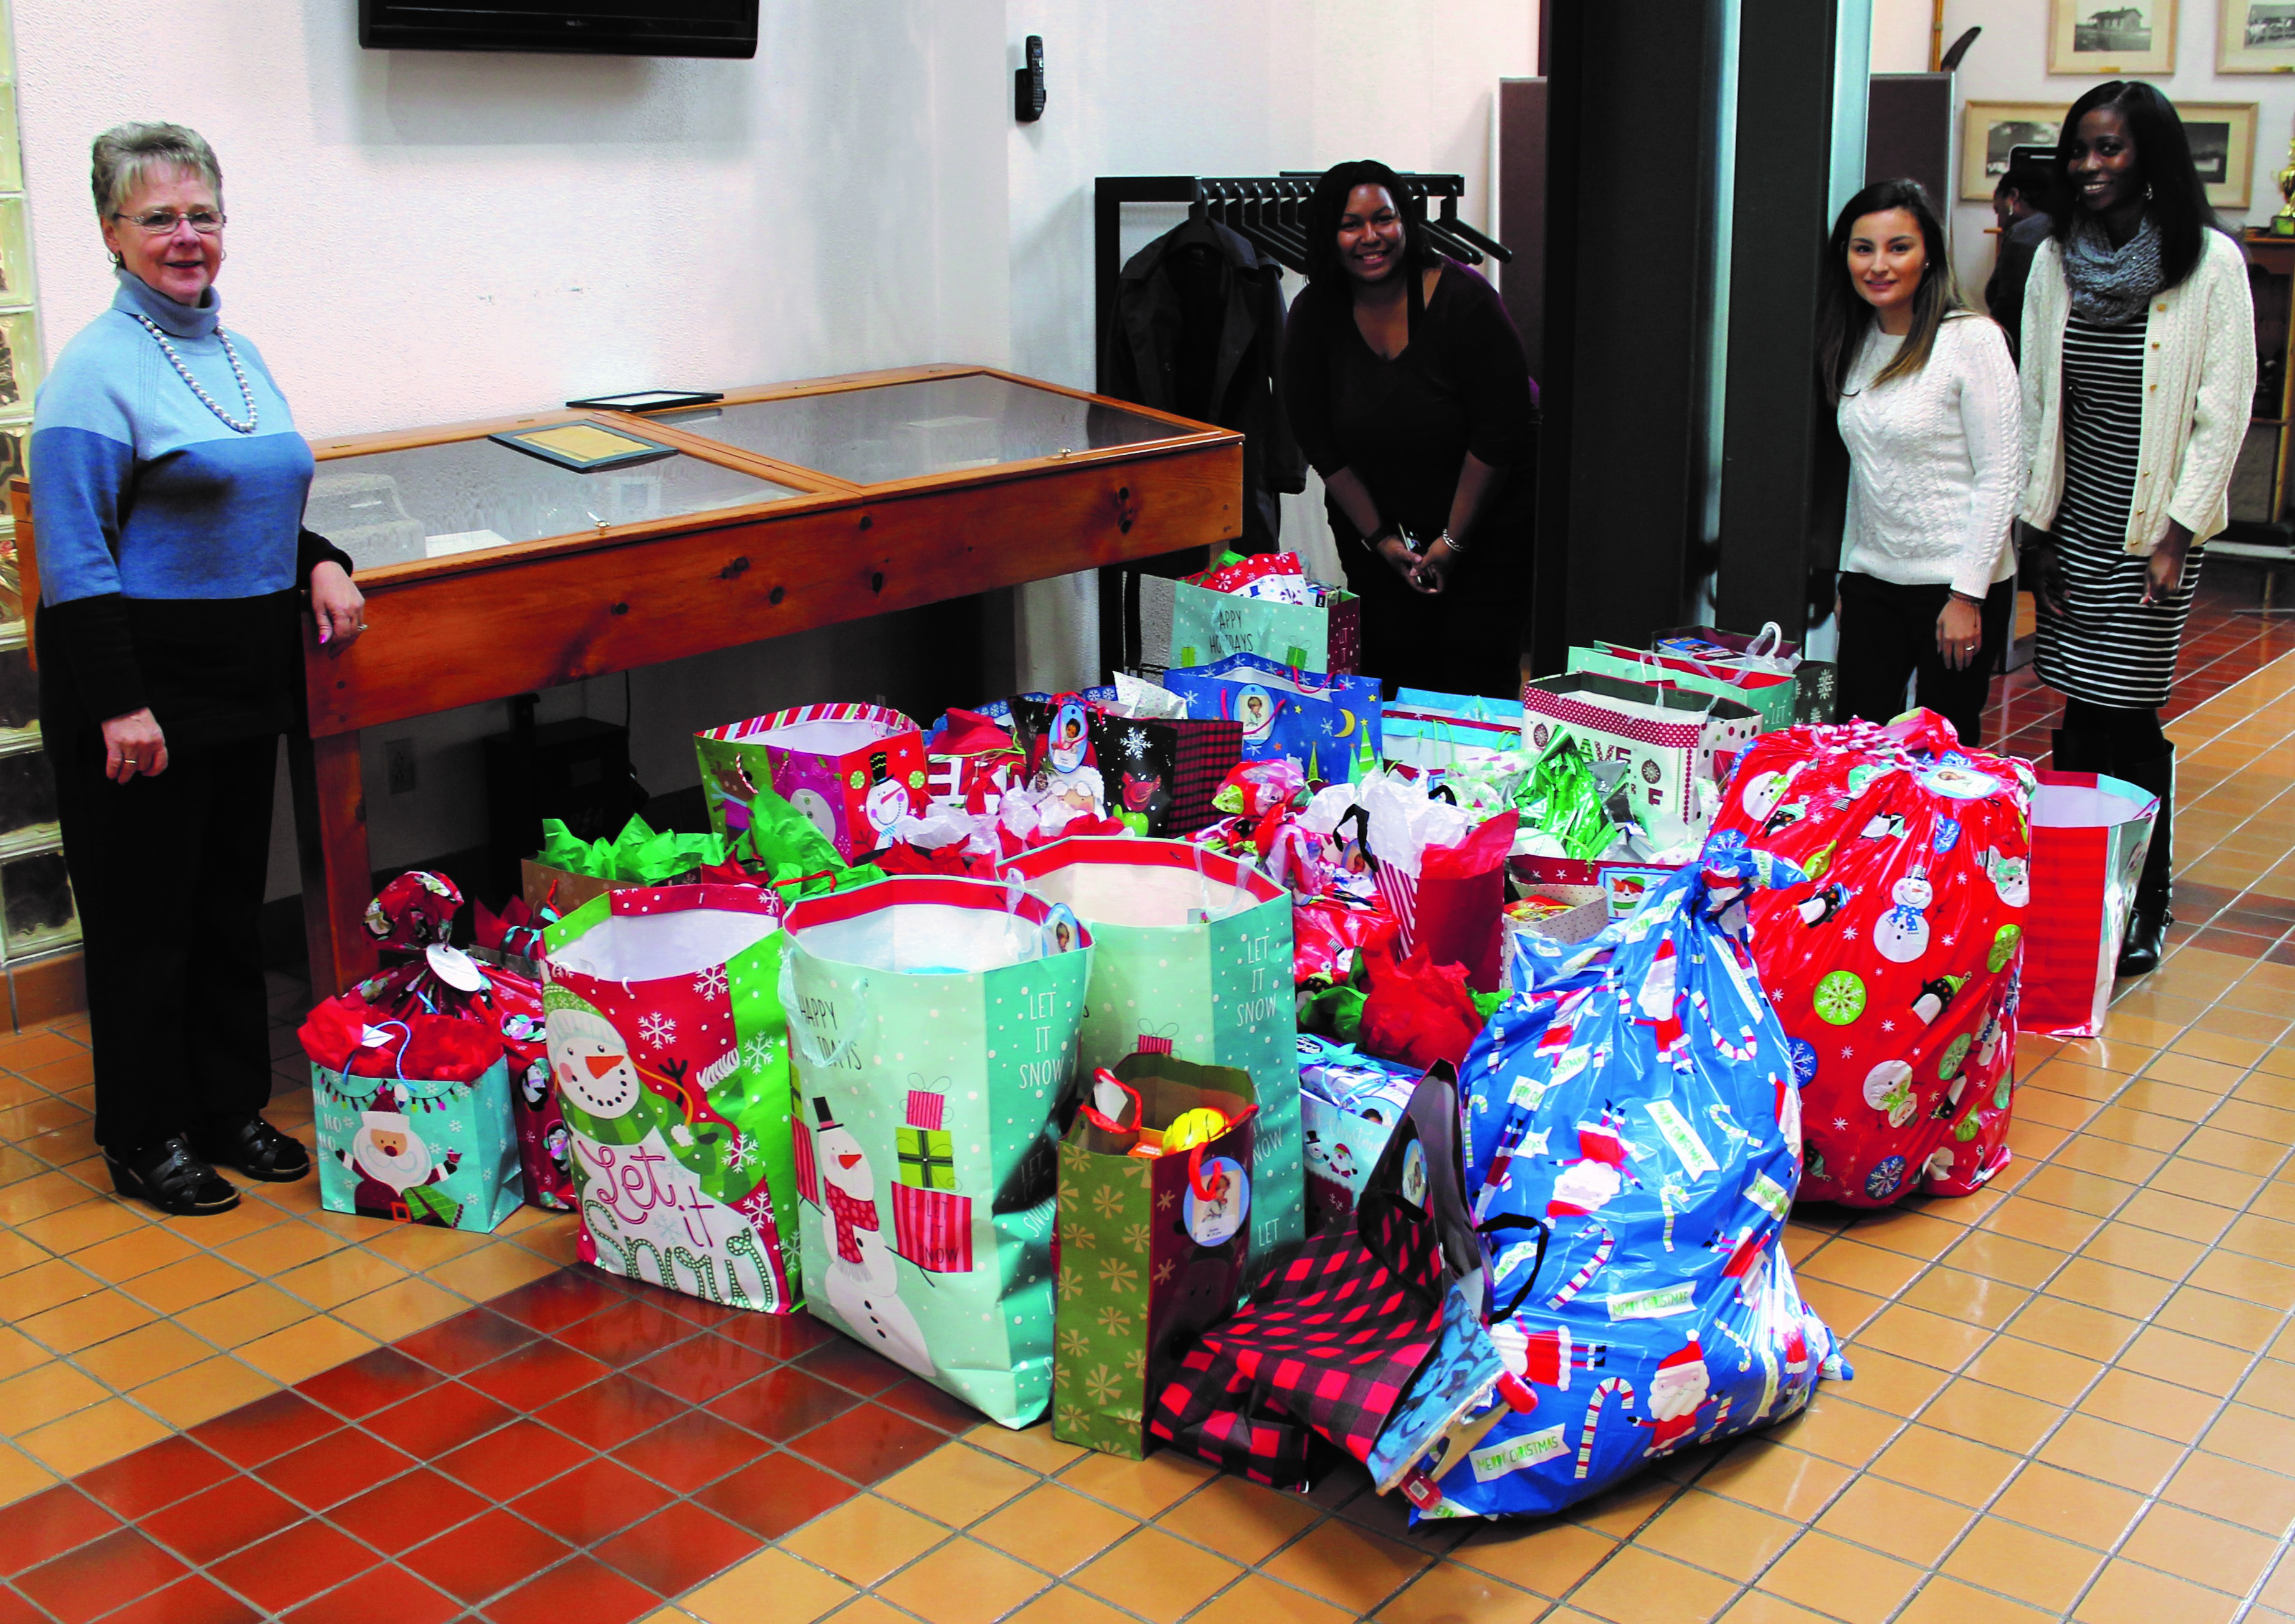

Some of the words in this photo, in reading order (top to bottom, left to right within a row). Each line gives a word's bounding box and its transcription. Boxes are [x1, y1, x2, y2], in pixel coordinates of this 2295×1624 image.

[1219, 610, 1242, 629] APPY
[1209, 634, 1253, 654] HODAYS
[1248, 936, 1270, 964] LET
[1252, 967, 1266, 994] IT
[797, 994, 837, 1030] HAPPY
[1030, 991, 1057, 1020] LET
[1237, 993, 1277, 1027] SNOW
[1035, 1026, 1052, 1053] IT
[1019, 1057, 1065, 1090] SNOW
[313, 1088, 328, 1108] HO
[323, 1113, 341, 1133] HO
[318, 1131, 336, 1151] HO
[1252, 1126, 1283, 1166] NOW
[577, 1140, 677, 1225] Let
[678, 1185, 715, 1248] it
[927, 1199, 949, 1220] LET
[1258, 1218, 1280, 1247] LET
[918, 1244, 959, 1264] SNOW
[1476, 1451, 1506, 1472] MERRY
